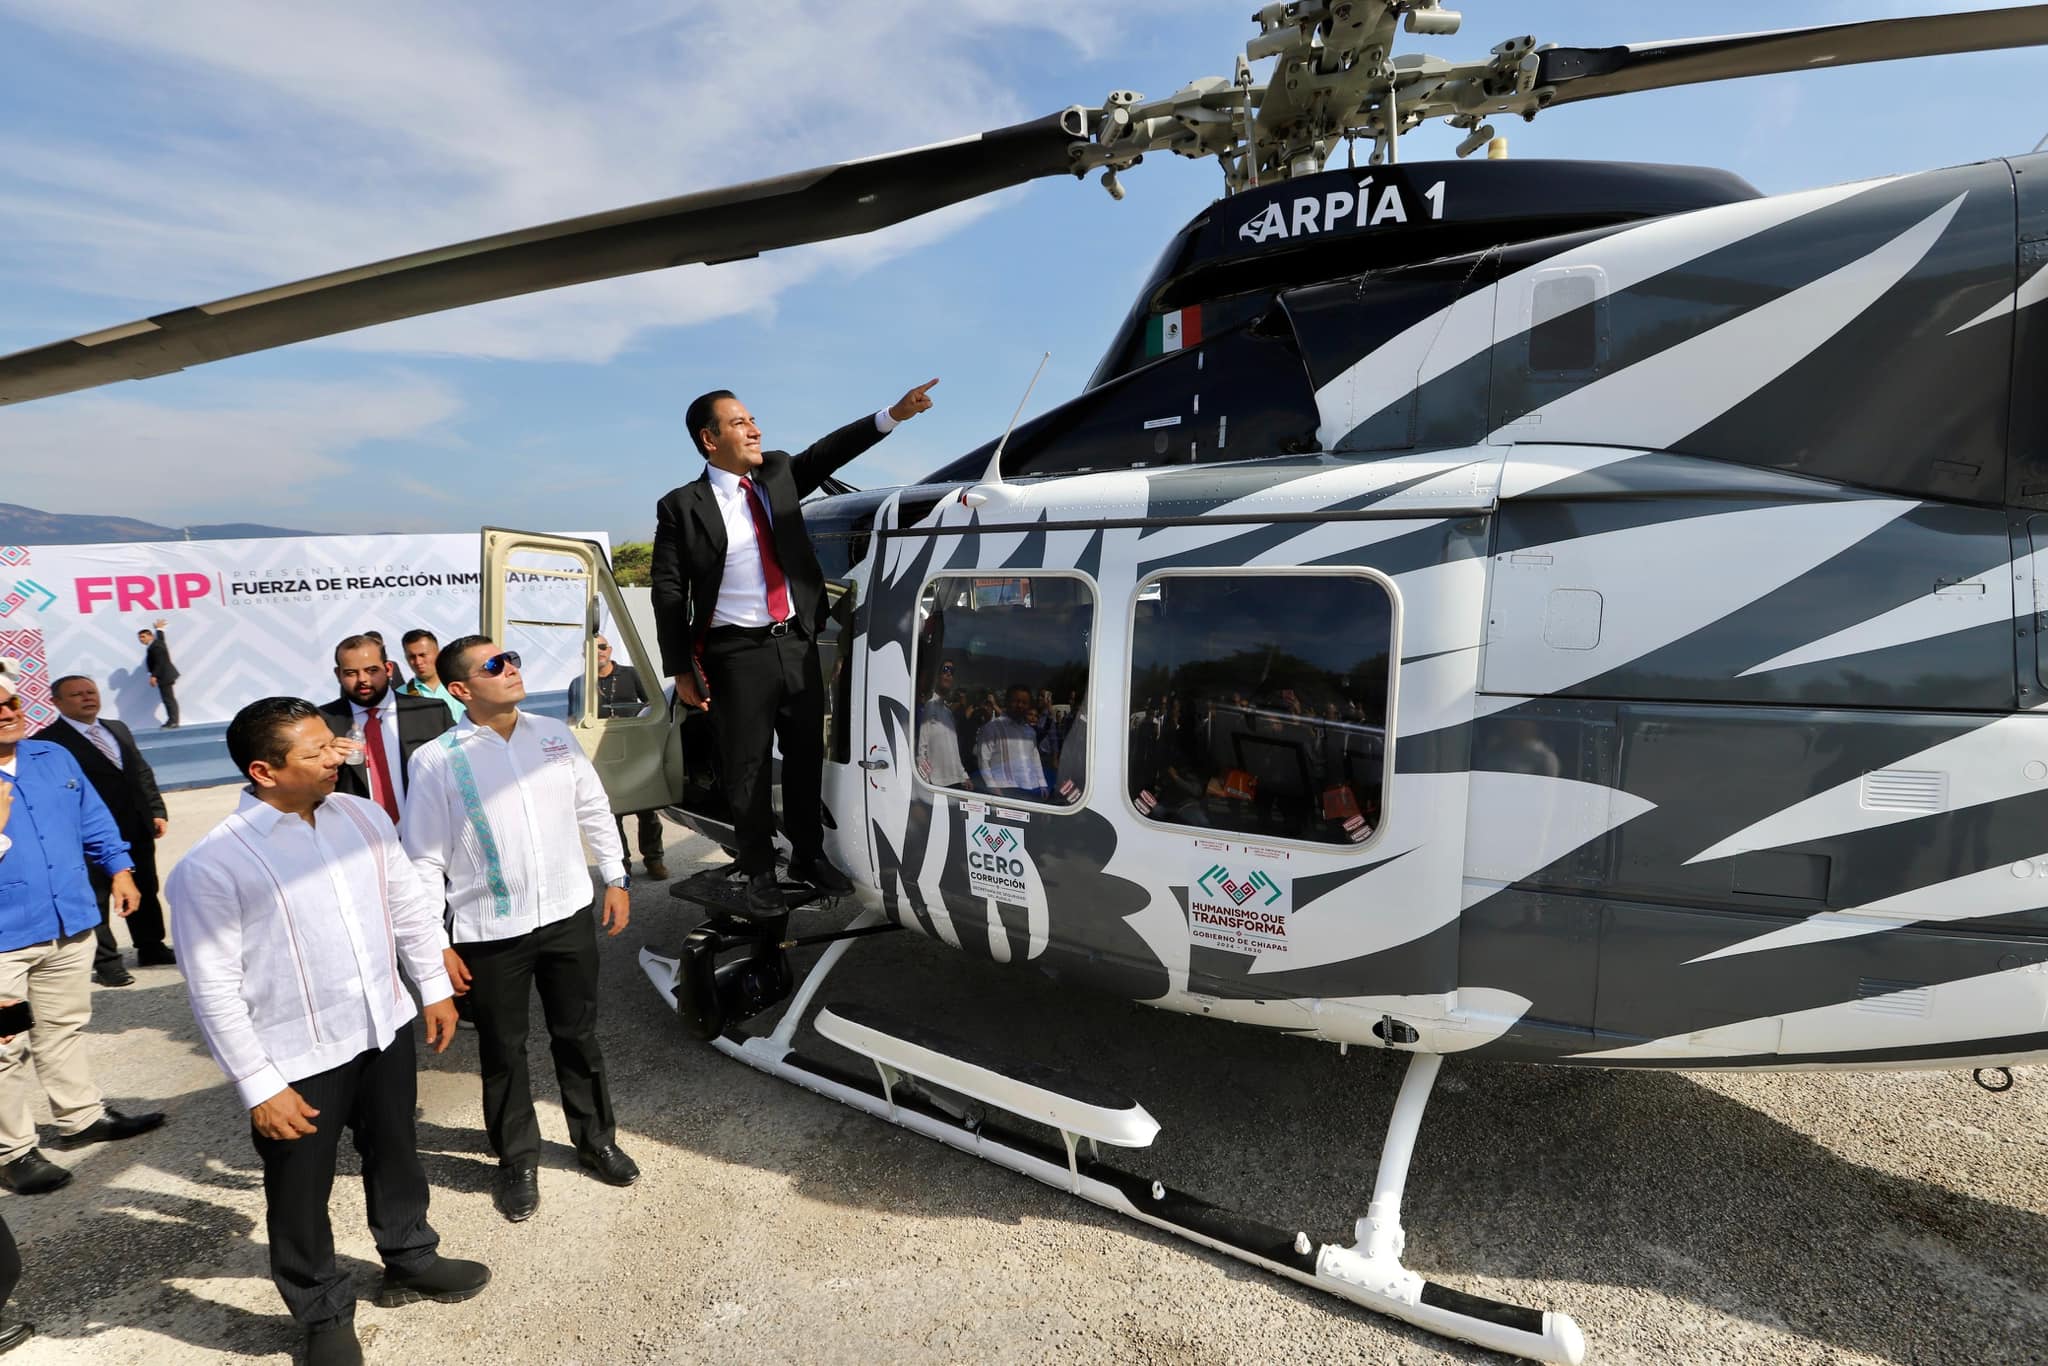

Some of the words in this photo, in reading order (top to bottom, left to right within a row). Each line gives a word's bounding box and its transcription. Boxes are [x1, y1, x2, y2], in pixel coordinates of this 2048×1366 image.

[1255, 175, 1407, 243] ARPÍA
[1424, 180, 1446, 220] 1
[74, 573, 211, 614] FRIP
[232, 580, 311, 595] FUERZA
[316, 578, 342, 591] DE
[347, 571, 442, 590] REACCIÓN
[969, 851, 1024, 877] CERO
[970, 872, 1025, 889] CORRUPCIÓN
[1192, 902, 1259, 920] HUMANISMO
[1261, 913, 1285, 925] QUE
[1192, 911, 1286, 936] TRANSFORMA
[1193, 930, 1235, 943] GOBIERNO
[1251, 940, 1288, 952] CHIAPAS
[1216, 941, 1234, 949] 2024
[1243, 945, 1262, 953] 2030
